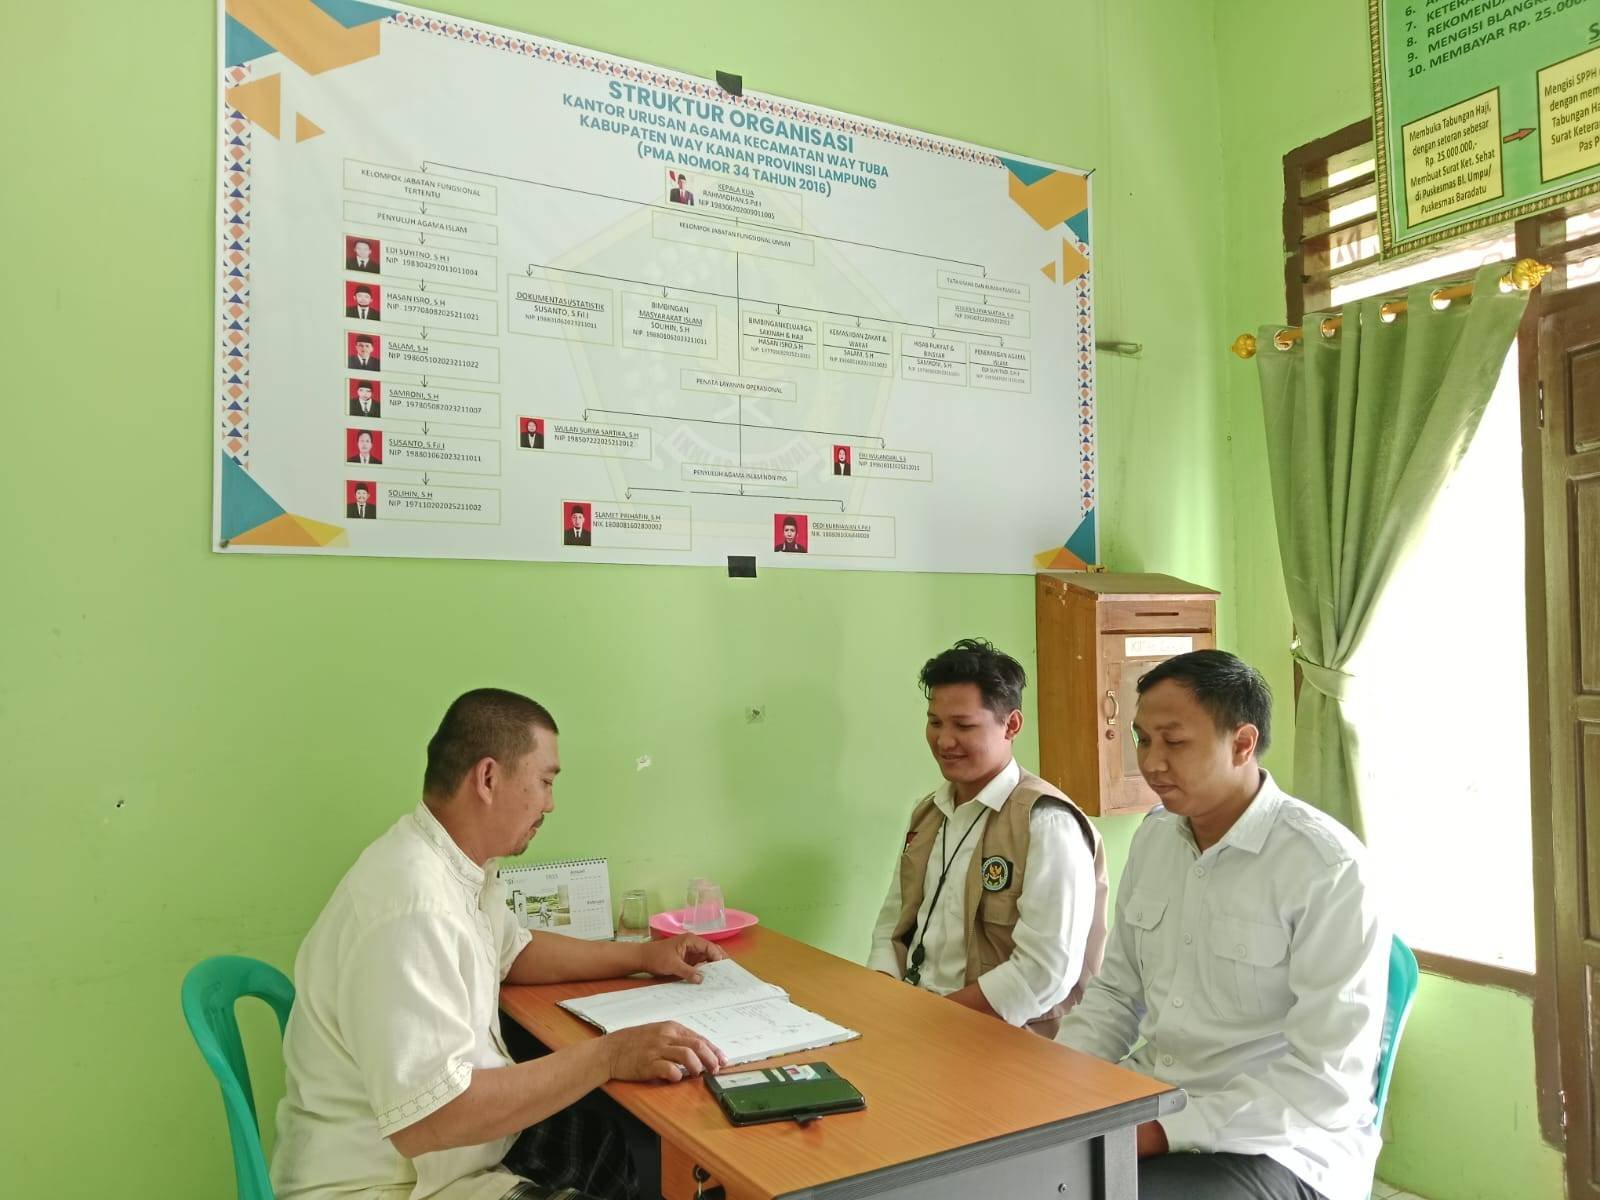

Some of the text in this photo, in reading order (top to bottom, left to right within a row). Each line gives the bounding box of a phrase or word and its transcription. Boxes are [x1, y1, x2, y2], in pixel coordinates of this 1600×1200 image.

[1405, 6, 1416, 16] 6.
[1405, 21, 1417, 32] 7.
[1406, 36, 1418, 47] 8.
[1407, 52, 1418, 63] 9.
[1427, 21, 1483, 53] MENGISI
[1408, 64, 1426, 78] 10.
[1429, 28, 1505, 68] MEMBAYAR
[1509, 20, 1531, 34] Rp.
[1544, 67, 1597, 97] Mengisi SPPH
[1549, 94, 1578, 112] dengan
[609, 80, 854, 153] STRUKTUR ORGANISASI
[1409, 100, 1492, 143] Membuka Tabungan Haji,
[1551, 107, 1590, 128] Tabungan
[563, 93, 889, 177] KANTOR URUSAN AGAMA KECAMATAN WAY TUBA
[1412, 119, 1490, 156] dengan setoran sebesar
[1551, 129, 1572, 145] Surat
[580, 114, 877, 189] KABUPATEN WAY KANAN PROVINSI LAMPUNG
[1579, 140, 1593, 152] Pas
[637, 141, 832, 198] (PMA NOMOR 34 TAHUN 2016)
[1410, 149, 1496, 188] Membuat Surat Ket. Sehat
[361, 169, 481, 197] KELOMPOK JABATAN FUNGSIONAL
[405, 186, 441, 198] TERTENTU
[718, 184, 755, 198] KEPALA KUA
[1415, 190, 1422, 201] di
[1422, 178, 1457, 199] Puskesmas
[1467, 163, 1492, 183] Umpu/
[1420, 184, 1487, 215] Puskesmas Baradatu
[377, 212, 468, 233] PENYULUH AGAMA ISLAM
[679, 221, 711, 233] KELOMPOK
[712, 227, 737, 237] JABATAN
[737, 232, 771, 244] FUNGSIONAL
[386, 292, 412, 303] HASAN
[651, 301, 689, 314] BIMBINGAN
[534, 304, 570, 316] SUSANTO,
[639, 309, 703, 326] MASYARAKAT ISLAM
[388, 341, 416, 352] SALAM,
[696, 378, 783, 394] PENATA LAYANAN OPERASIONAL
[554, 425, 579, 434] WULAN
[580, 427, 600, 435] SURYA
